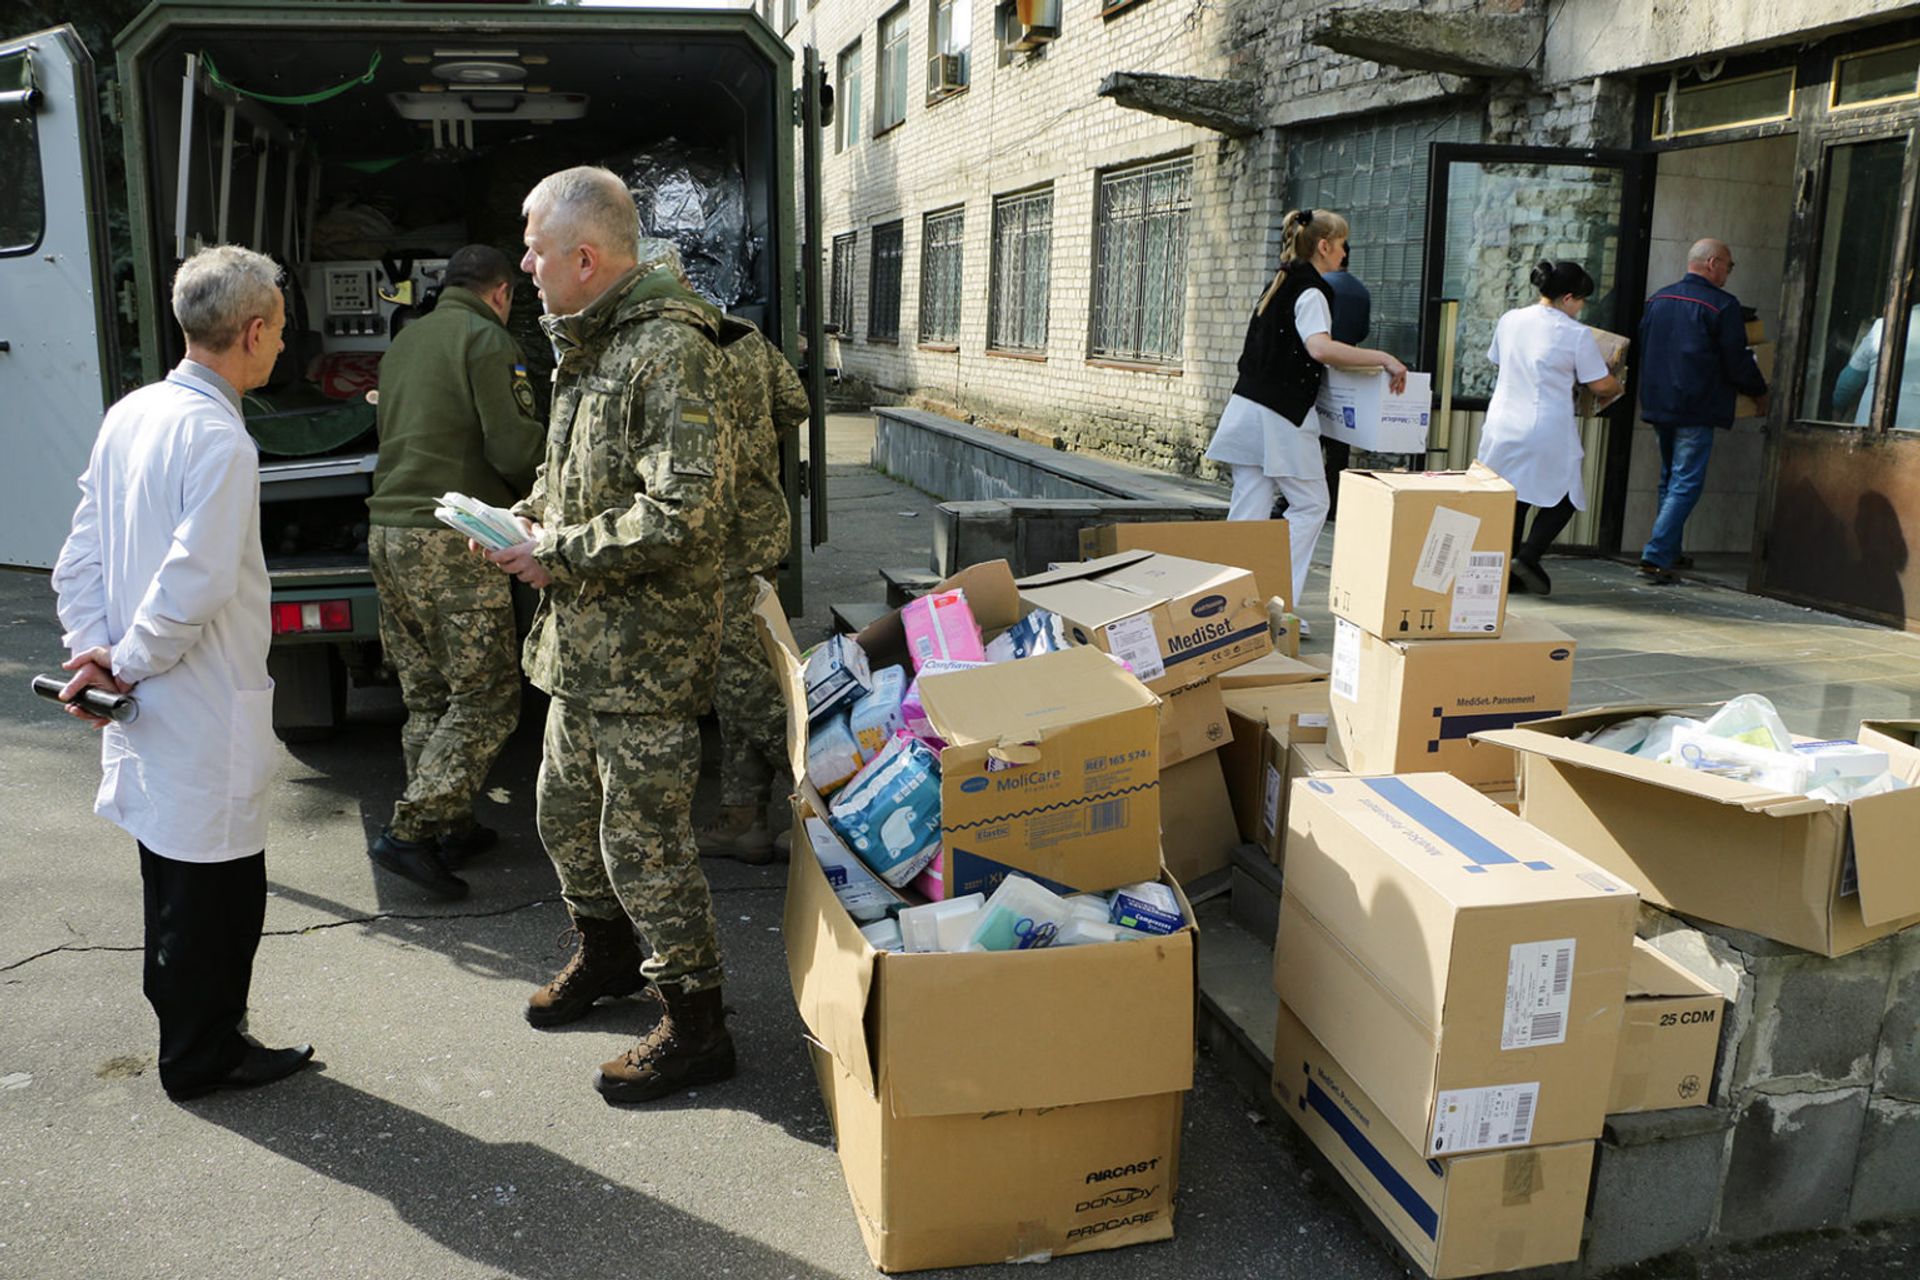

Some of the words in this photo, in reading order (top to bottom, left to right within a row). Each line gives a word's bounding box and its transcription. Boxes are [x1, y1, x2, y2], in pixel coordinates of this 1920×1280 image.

[1168, 618, 1233, 653] MediSet
[1492, 695, 1535, 705] Pansement
[997, 769, 1061, 792] MoliCare
[977, 827, 1009, 840] Elastic
[1660, 1013, 1678, 1026] 25
[1681, 1009, 1715, 1024] CDM
[1086, 1158, 1159, 1184] AIRCAST
[1067, 1211, 1159, 1239] PROCARE
